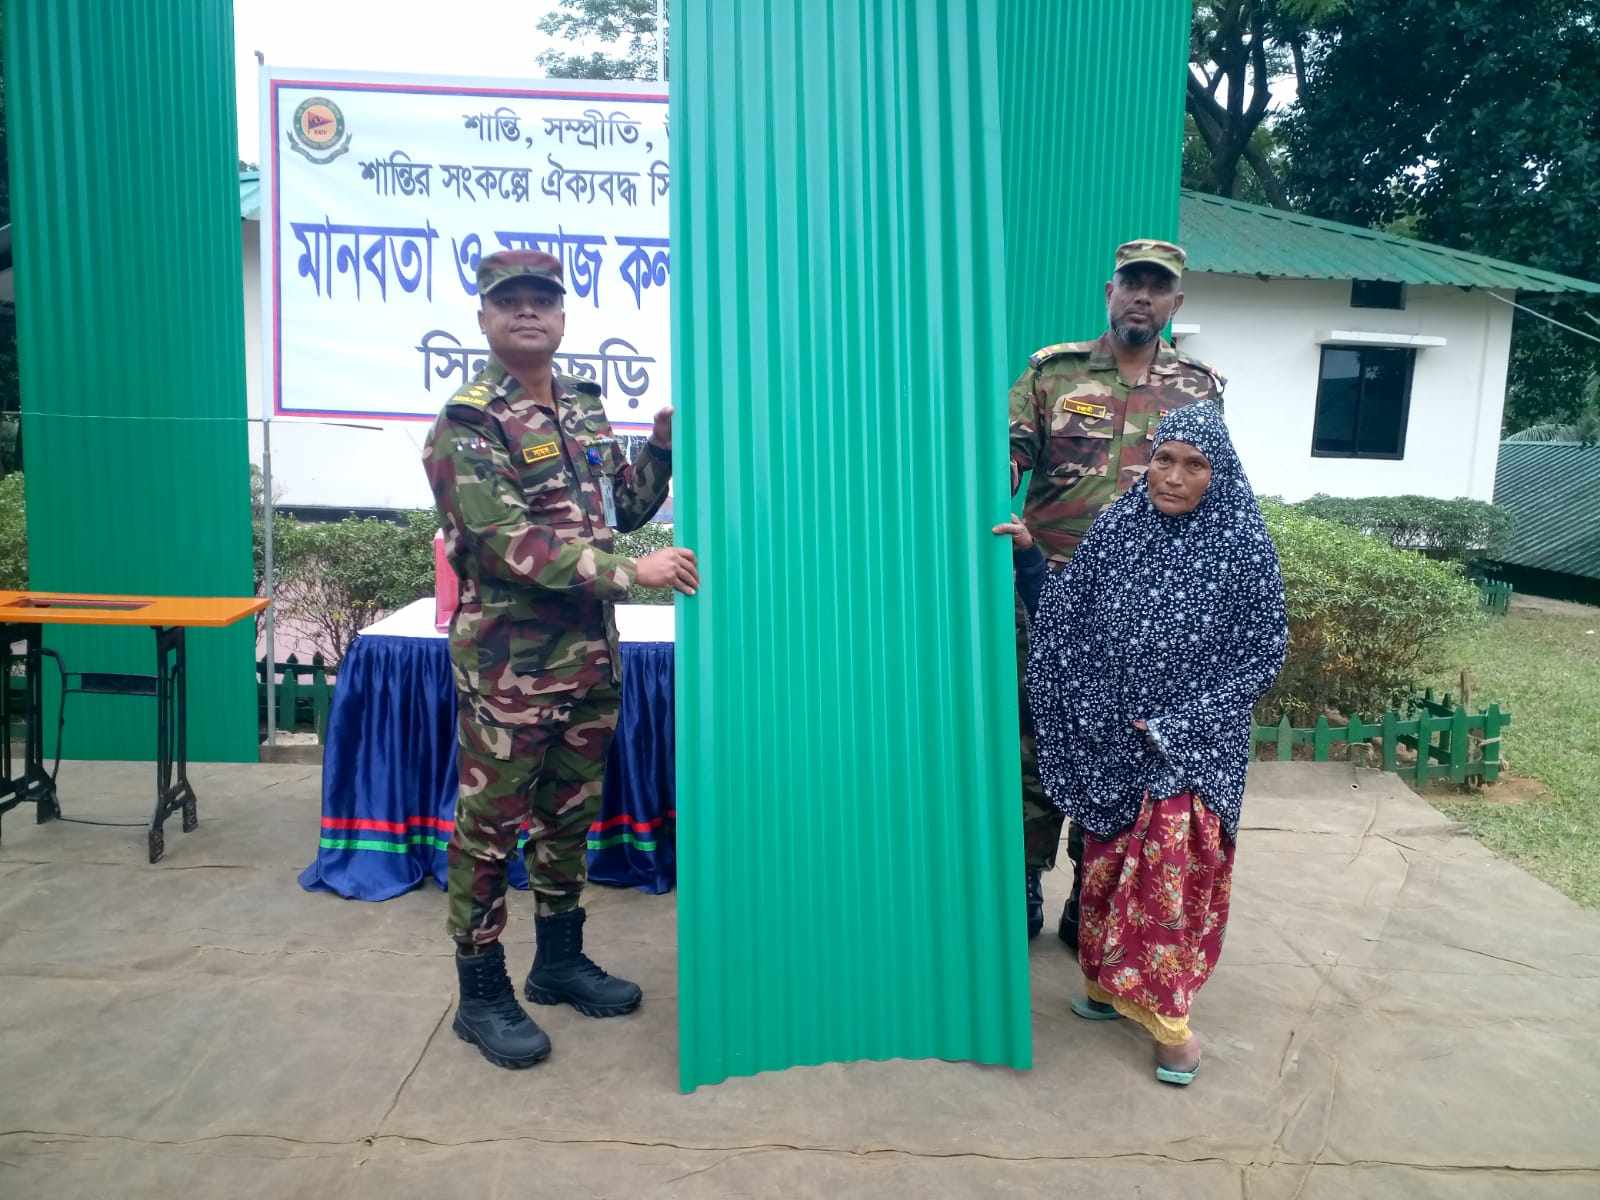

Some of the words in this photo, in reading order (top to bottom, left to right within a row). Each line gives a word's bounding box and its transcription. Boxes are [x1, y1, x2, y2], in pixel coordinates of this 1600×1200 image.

[462, 107, 533, 149] শান্তি,
[542, 109, 653, 153] সম্প্রীতি,
[358, 149, 433, 197] শান্তির
[439, 163, 533, 202] সংকল্পে
[541, 153, 641, 207] ঐক্যবদ্ধ
[290, 215, 439, 303] মানবতা
[451, 232, 481, 297] ও
